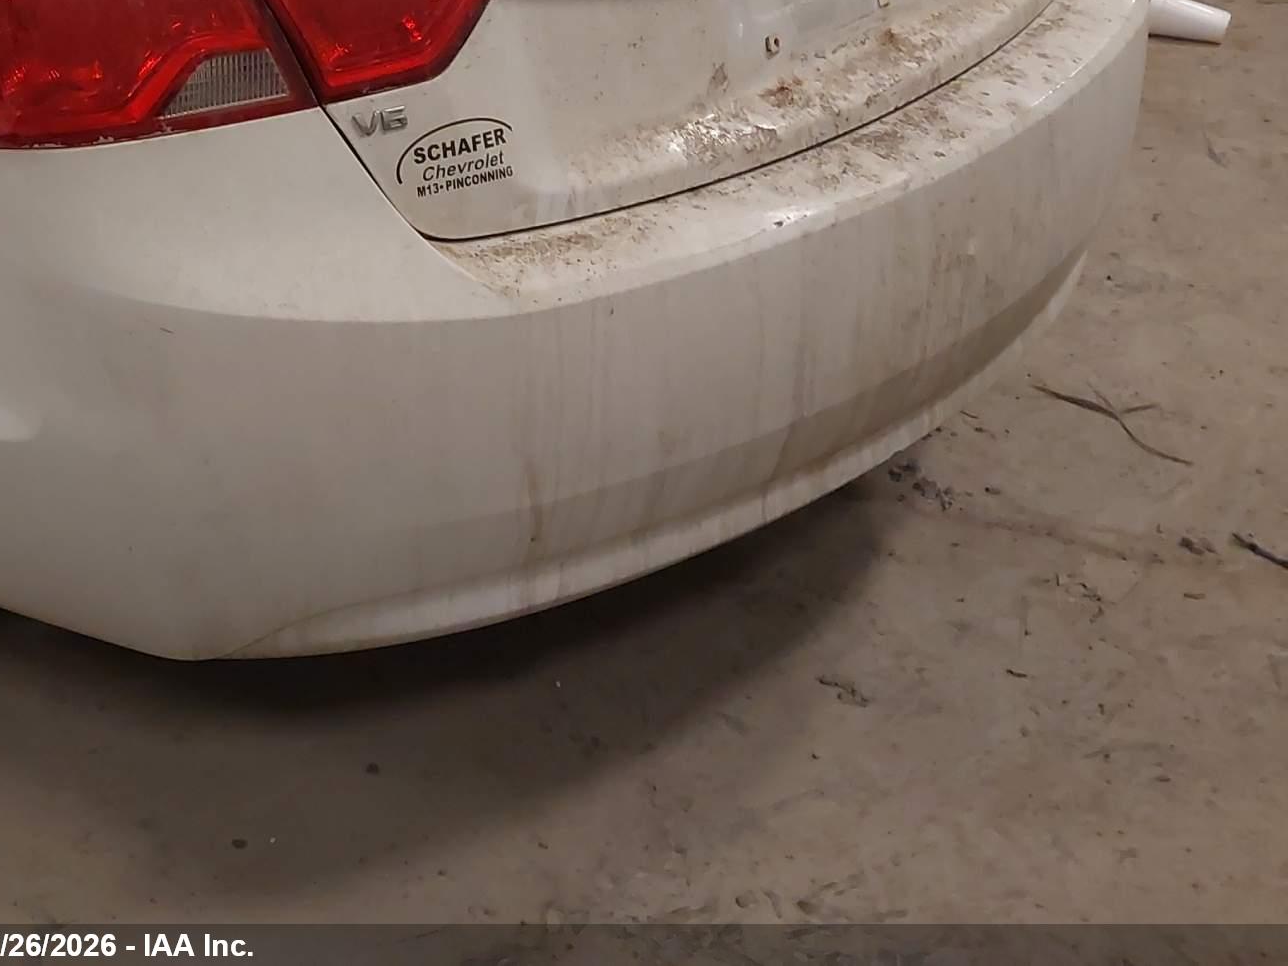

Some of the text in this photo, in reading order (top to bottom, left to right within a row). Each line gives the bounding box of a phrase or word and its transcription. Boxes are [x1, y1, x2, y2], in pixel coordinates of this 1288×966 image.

[351, 105, 409, 137] V6
[413, 128, 507, 164] SCHAFER
[422, 150, 505, 182] Chevrolet
